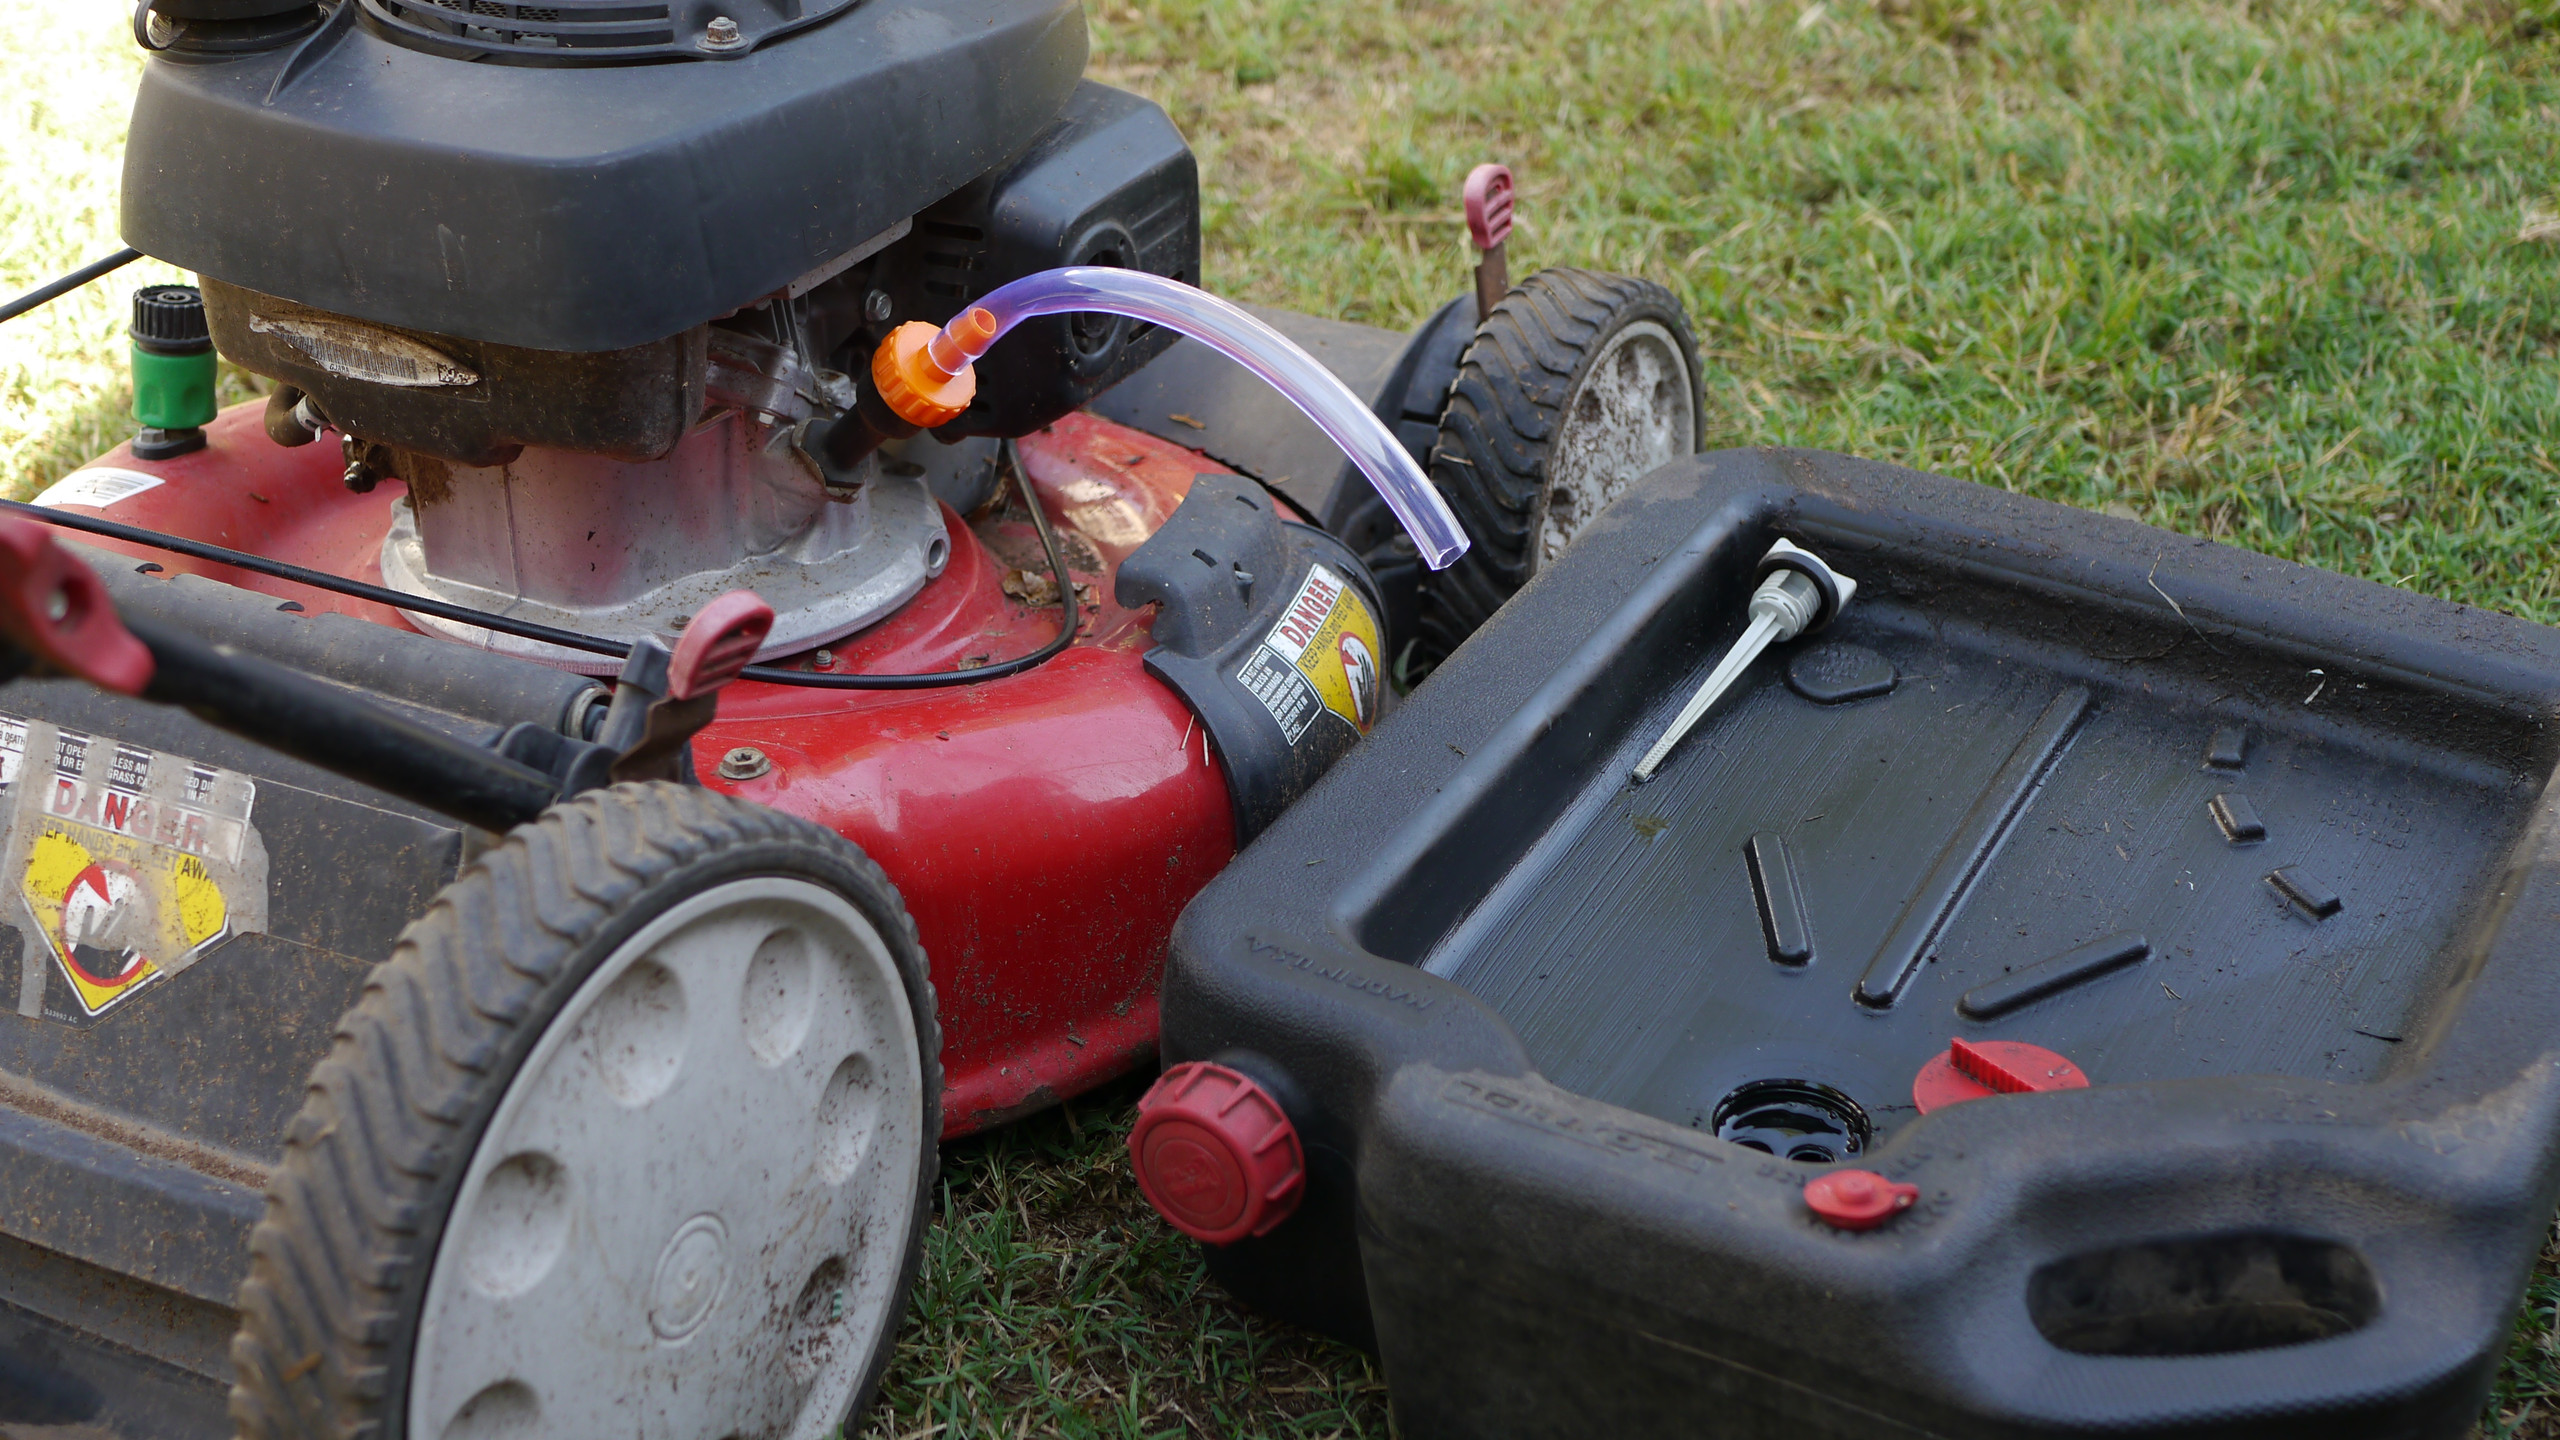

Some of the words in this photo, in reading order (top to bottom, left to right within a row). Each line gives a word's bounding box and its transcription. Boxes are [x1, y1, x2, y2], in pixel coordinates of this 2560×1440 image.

[1280, 578, 1338, 649] DANGER
[1253, 648, 1272, 670] OPERATE
[1300, 642, 1320, 672] KEEP
[1316, 625, 1335, 656] HANDS
[1241, 674, 1252, 684] DO
[1246, 666, 1258, 678] NOT
[1250, 672, 1268, 692] UNLESS
[1263, 666, 1274, 676] AN
[4, 732, 25, 746] DEATH
[55, 741, 66, 752] OT
[66, 744, 88, 759] OPER
[134, 762, 147, 774] AN
[62, 756, 75, 769] OR
[107, 768, 136, 785] GRASS
[187, 789, 196, 800] IN
[52, 778, 207, 854] DANGER
[66, 824, 114, 855] HANDS
[1315, 967, 1350, 982] IN
[1346, 976, 1435, 1012] MADE
